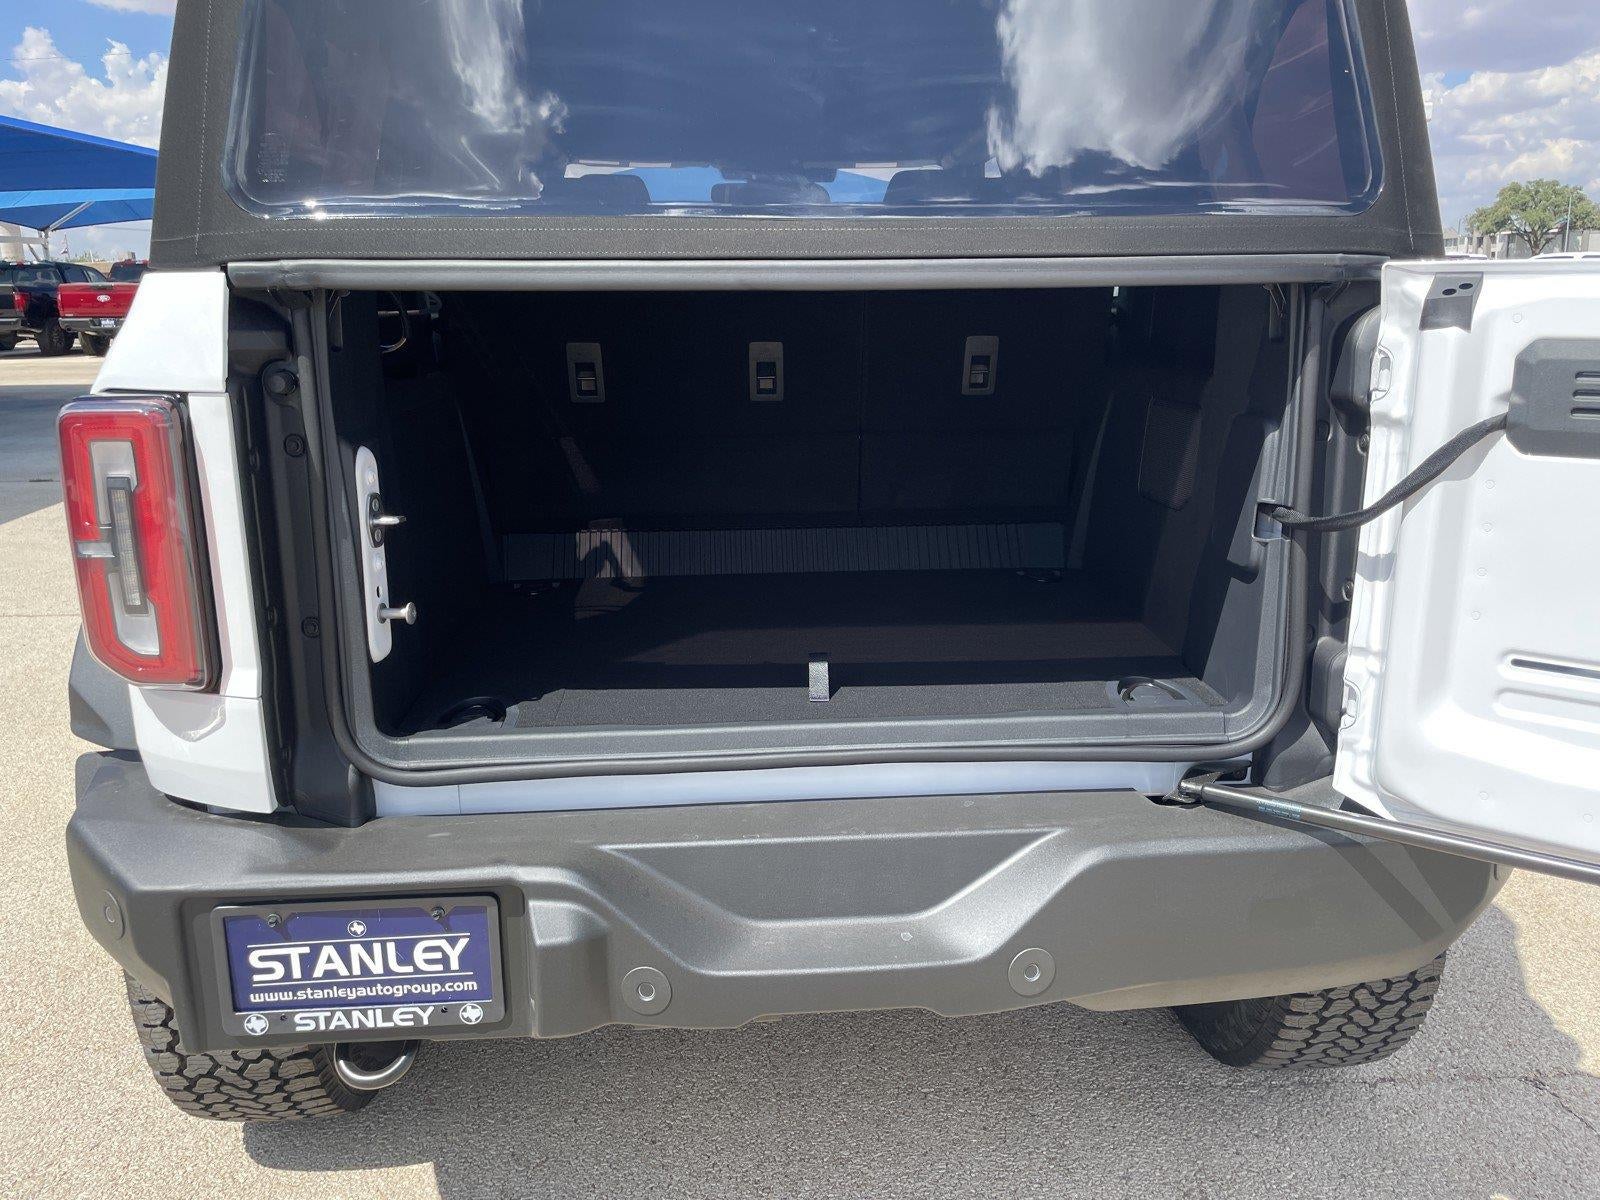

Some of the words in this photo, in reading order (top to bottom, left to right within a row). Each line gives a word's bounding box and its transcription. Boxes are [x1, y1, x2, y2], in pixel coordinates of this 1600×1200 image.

[248, 938, 470, 982] STANLEY
[250, 979, 478, 1003] www.stanleyautogroup.com
[294, 1005, 435, 1032] STANLEY
